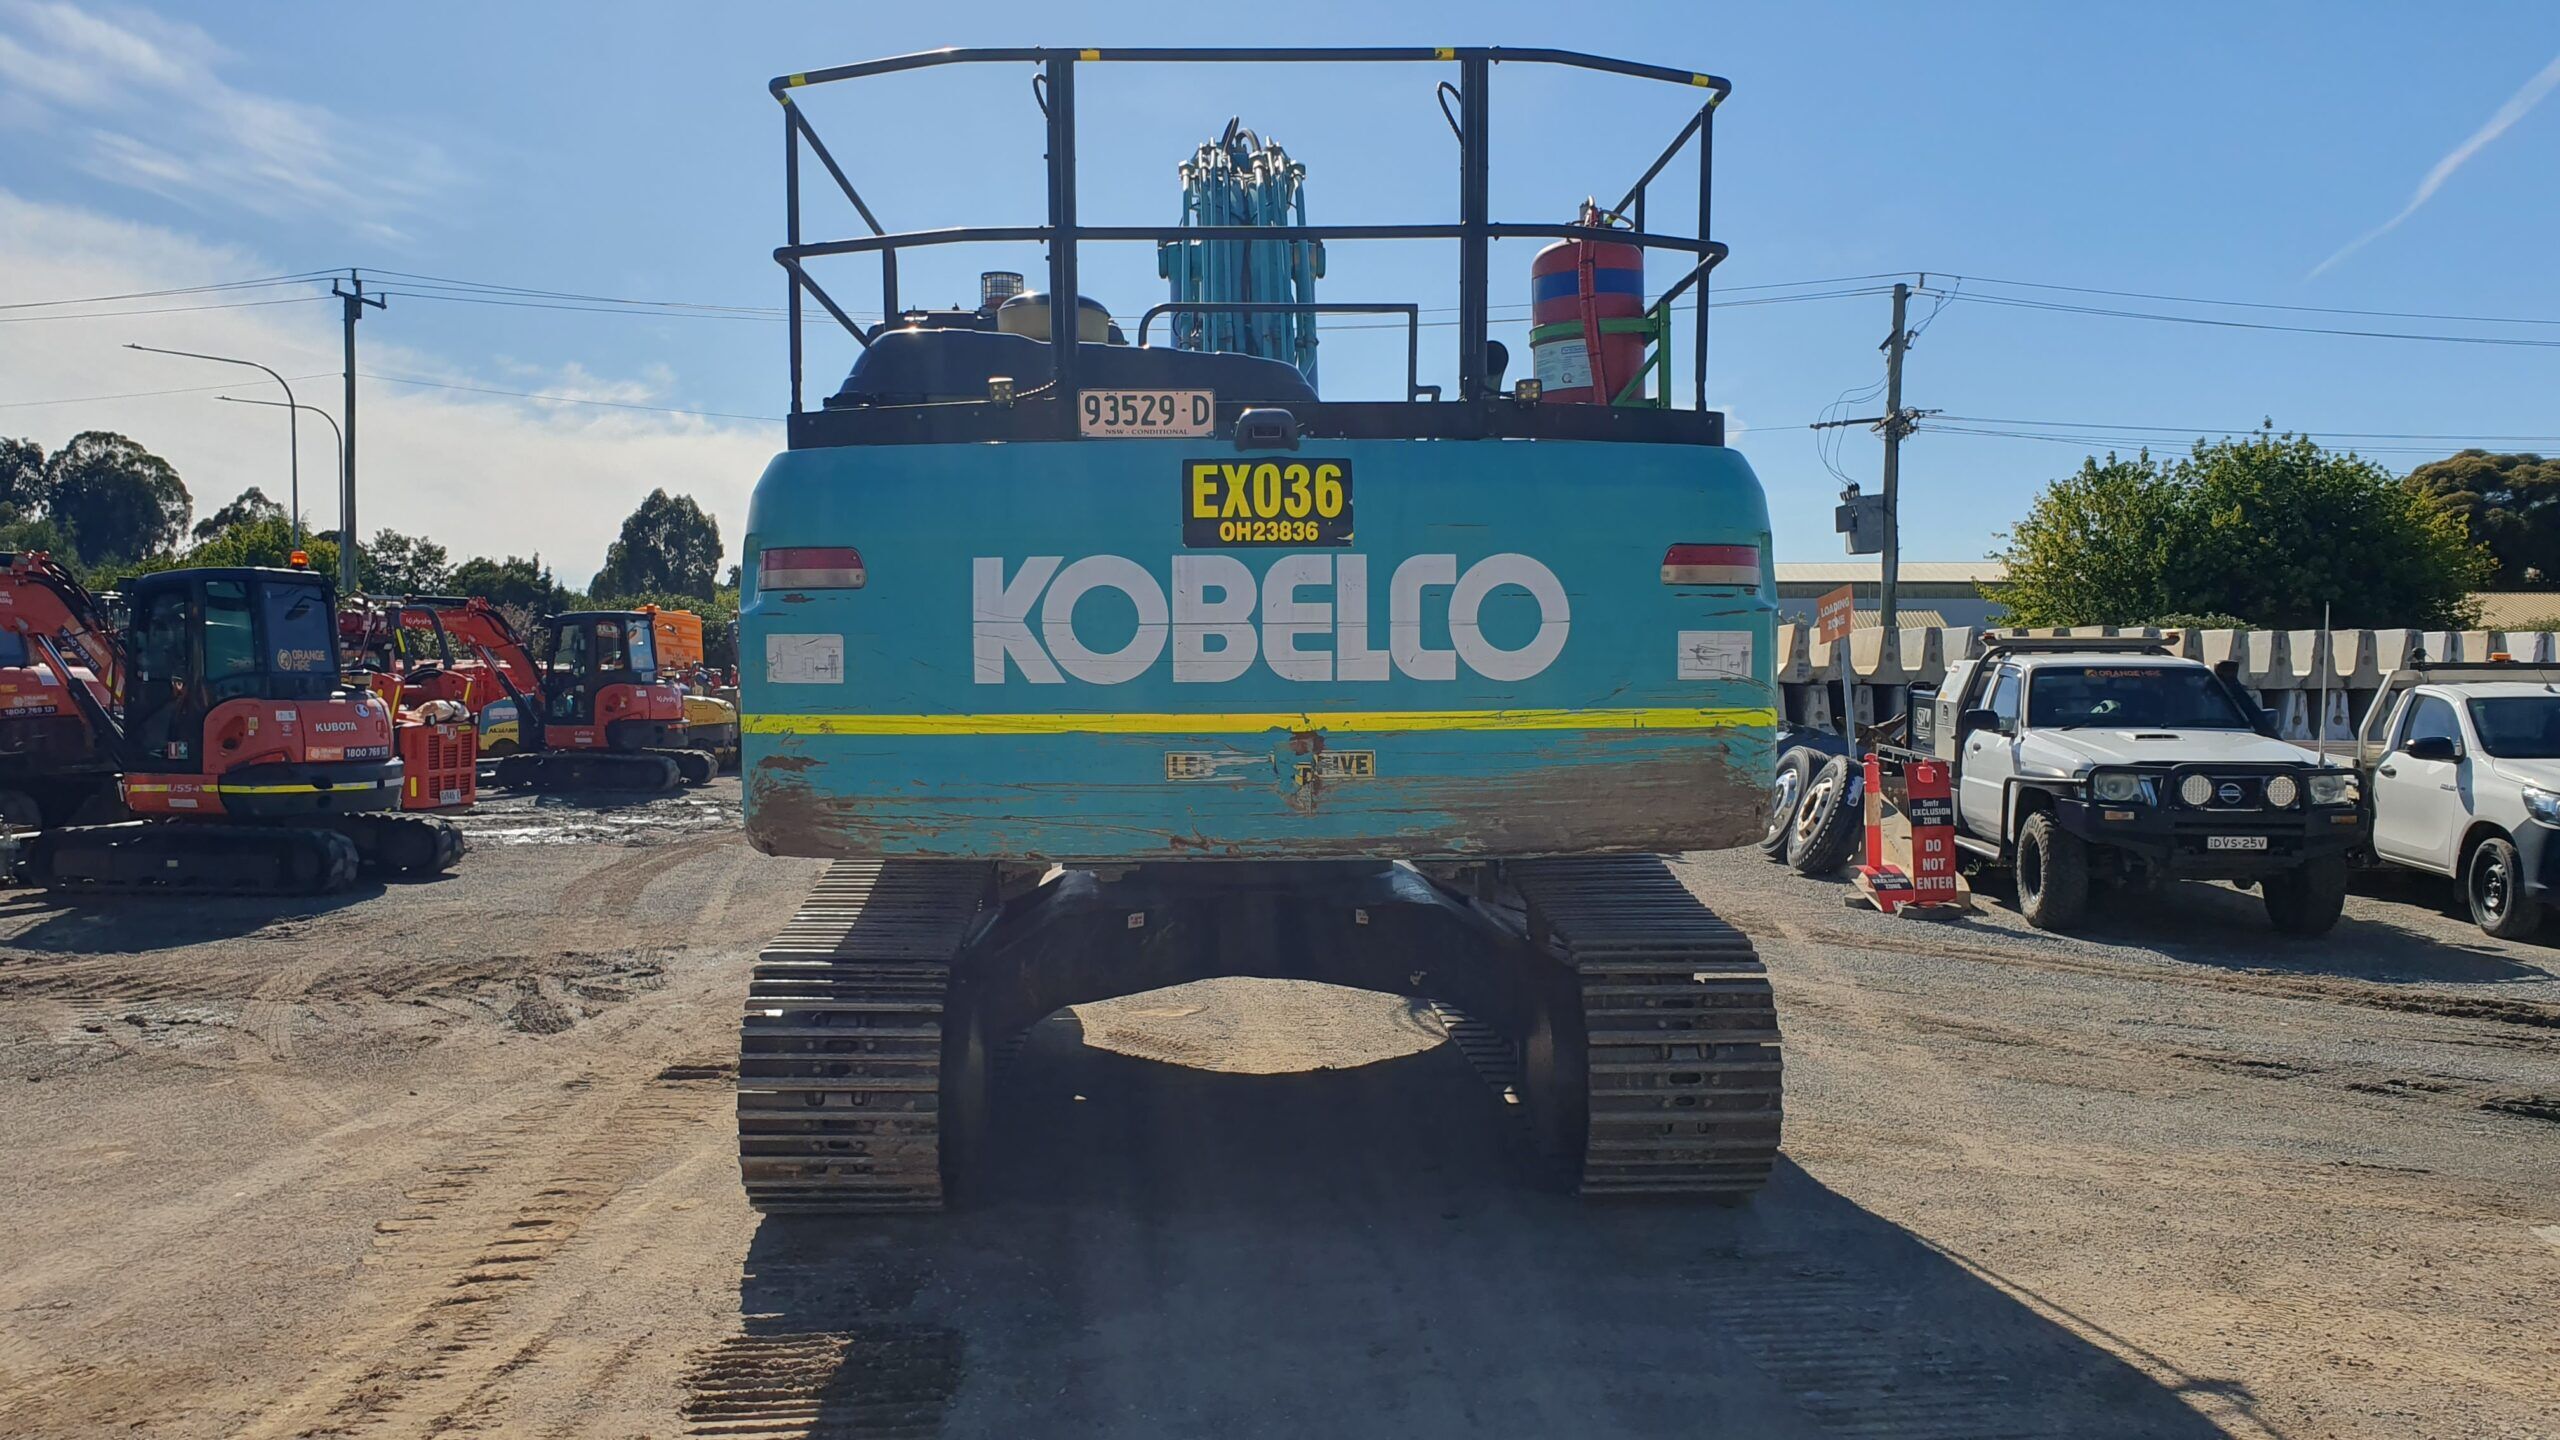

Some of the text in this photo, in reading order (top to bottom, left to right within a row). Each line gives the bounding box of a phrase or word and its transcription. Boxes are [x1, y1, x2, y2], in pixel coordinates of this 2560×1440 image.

[1192, 463, 1344, 519] EX036
[1219, 520, 1319, 542] OH23836
[1820, 596, 1850, 618] LOADING
[973, 552, 1571, 685] KOBELCO
[1827, 614, 1846, 631] ZONE
[292, 649, 326, 661] ORANGE
[315, 722, 358, 732] KUBOTA
[346, 748, 367, 757] 1800
[1912, 807, 1952, 817] EXCLUSION
[1923, 816, 1942, 825] ZONE
[1925, 839, 1942, 852] DO
[1922, 858, 1946, 871] NOT
[1916, 876, 1954, 890] ENTER
